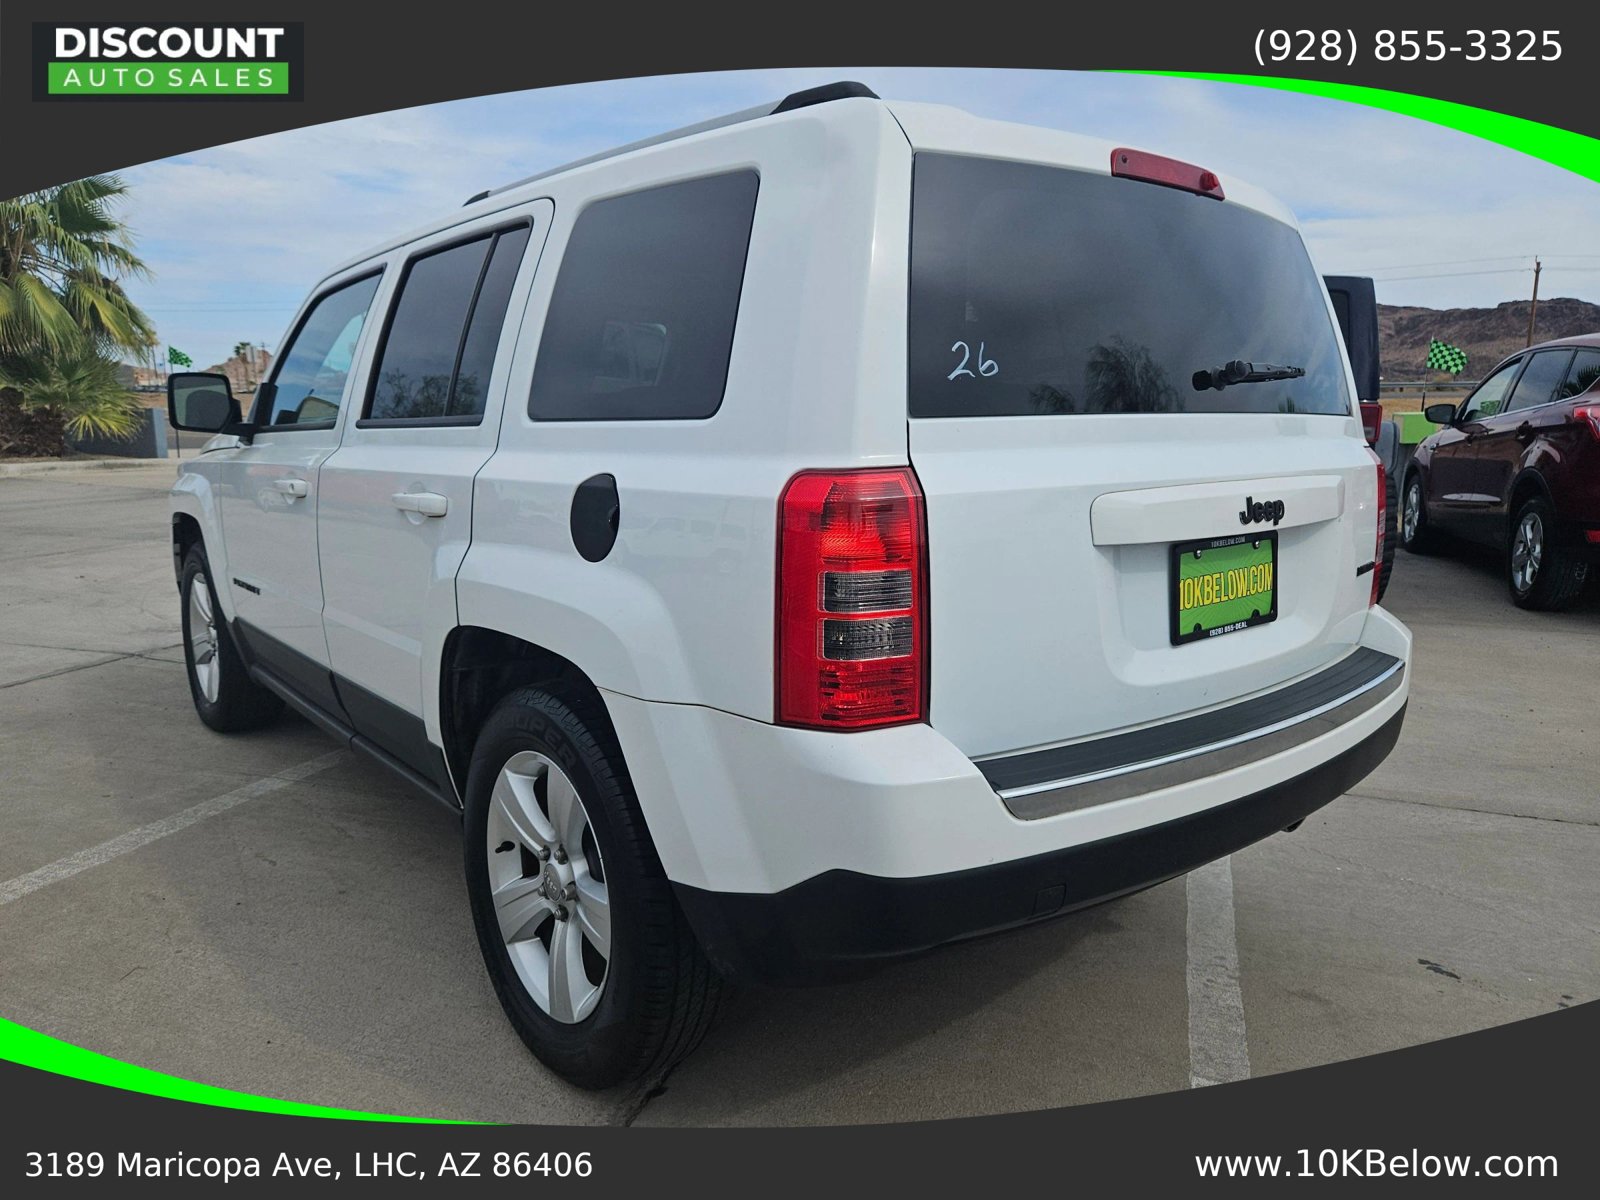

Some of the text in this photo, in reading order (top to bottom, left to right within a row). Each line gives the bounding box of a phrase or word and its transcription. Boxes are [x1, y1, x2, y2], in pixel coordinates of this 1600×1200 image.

[947, 341, 999, 381] 26
[1239, 496, 1285, 526] Jeep
[1179, 561, 1274, 611] 10KBELOW.COM
